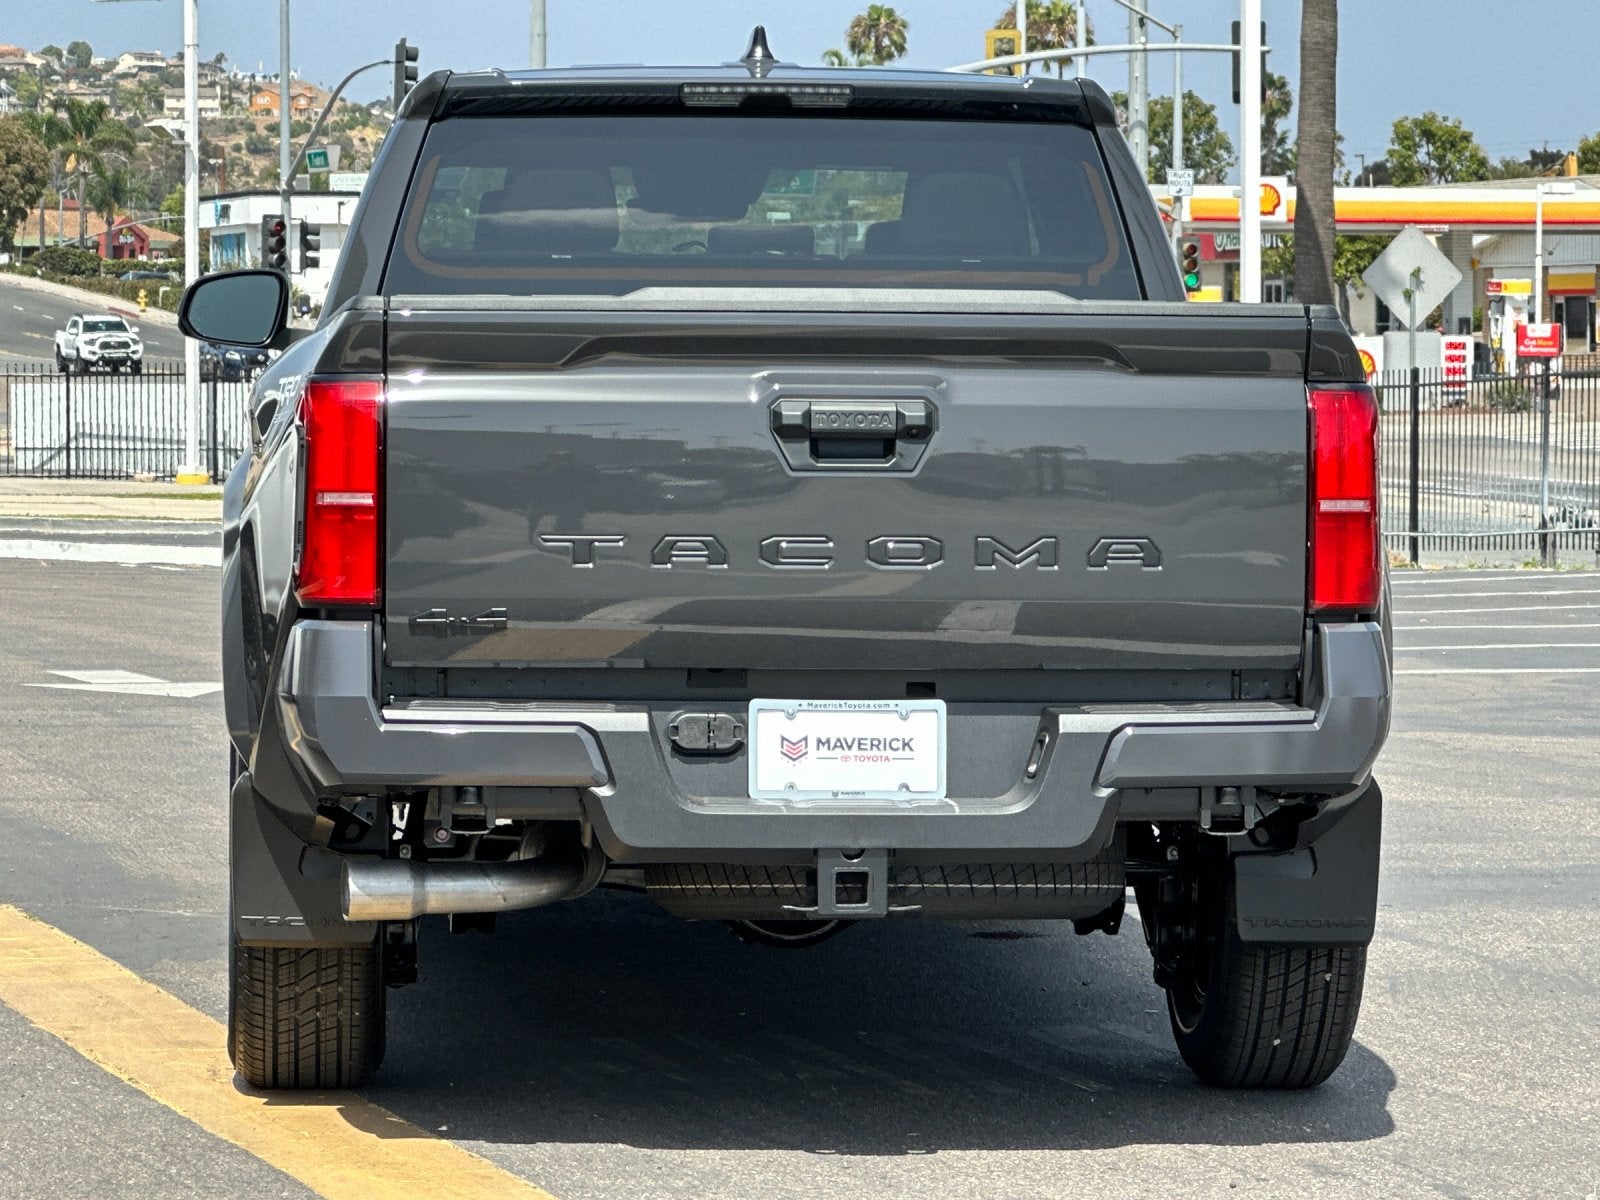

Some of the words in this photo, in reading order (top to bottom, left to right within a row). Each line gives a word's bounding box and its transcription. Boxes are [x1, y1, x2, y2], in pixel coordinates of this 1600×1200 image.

[815, 412, 893, 428] TOYOTA
[538, 533, 1164, 573] TACOMA
[816, 737, 915, 752] MAVERICK
[854, 755, 890, 763] TOYOTA
[1243, 917, 1369, 929] TACOMA
